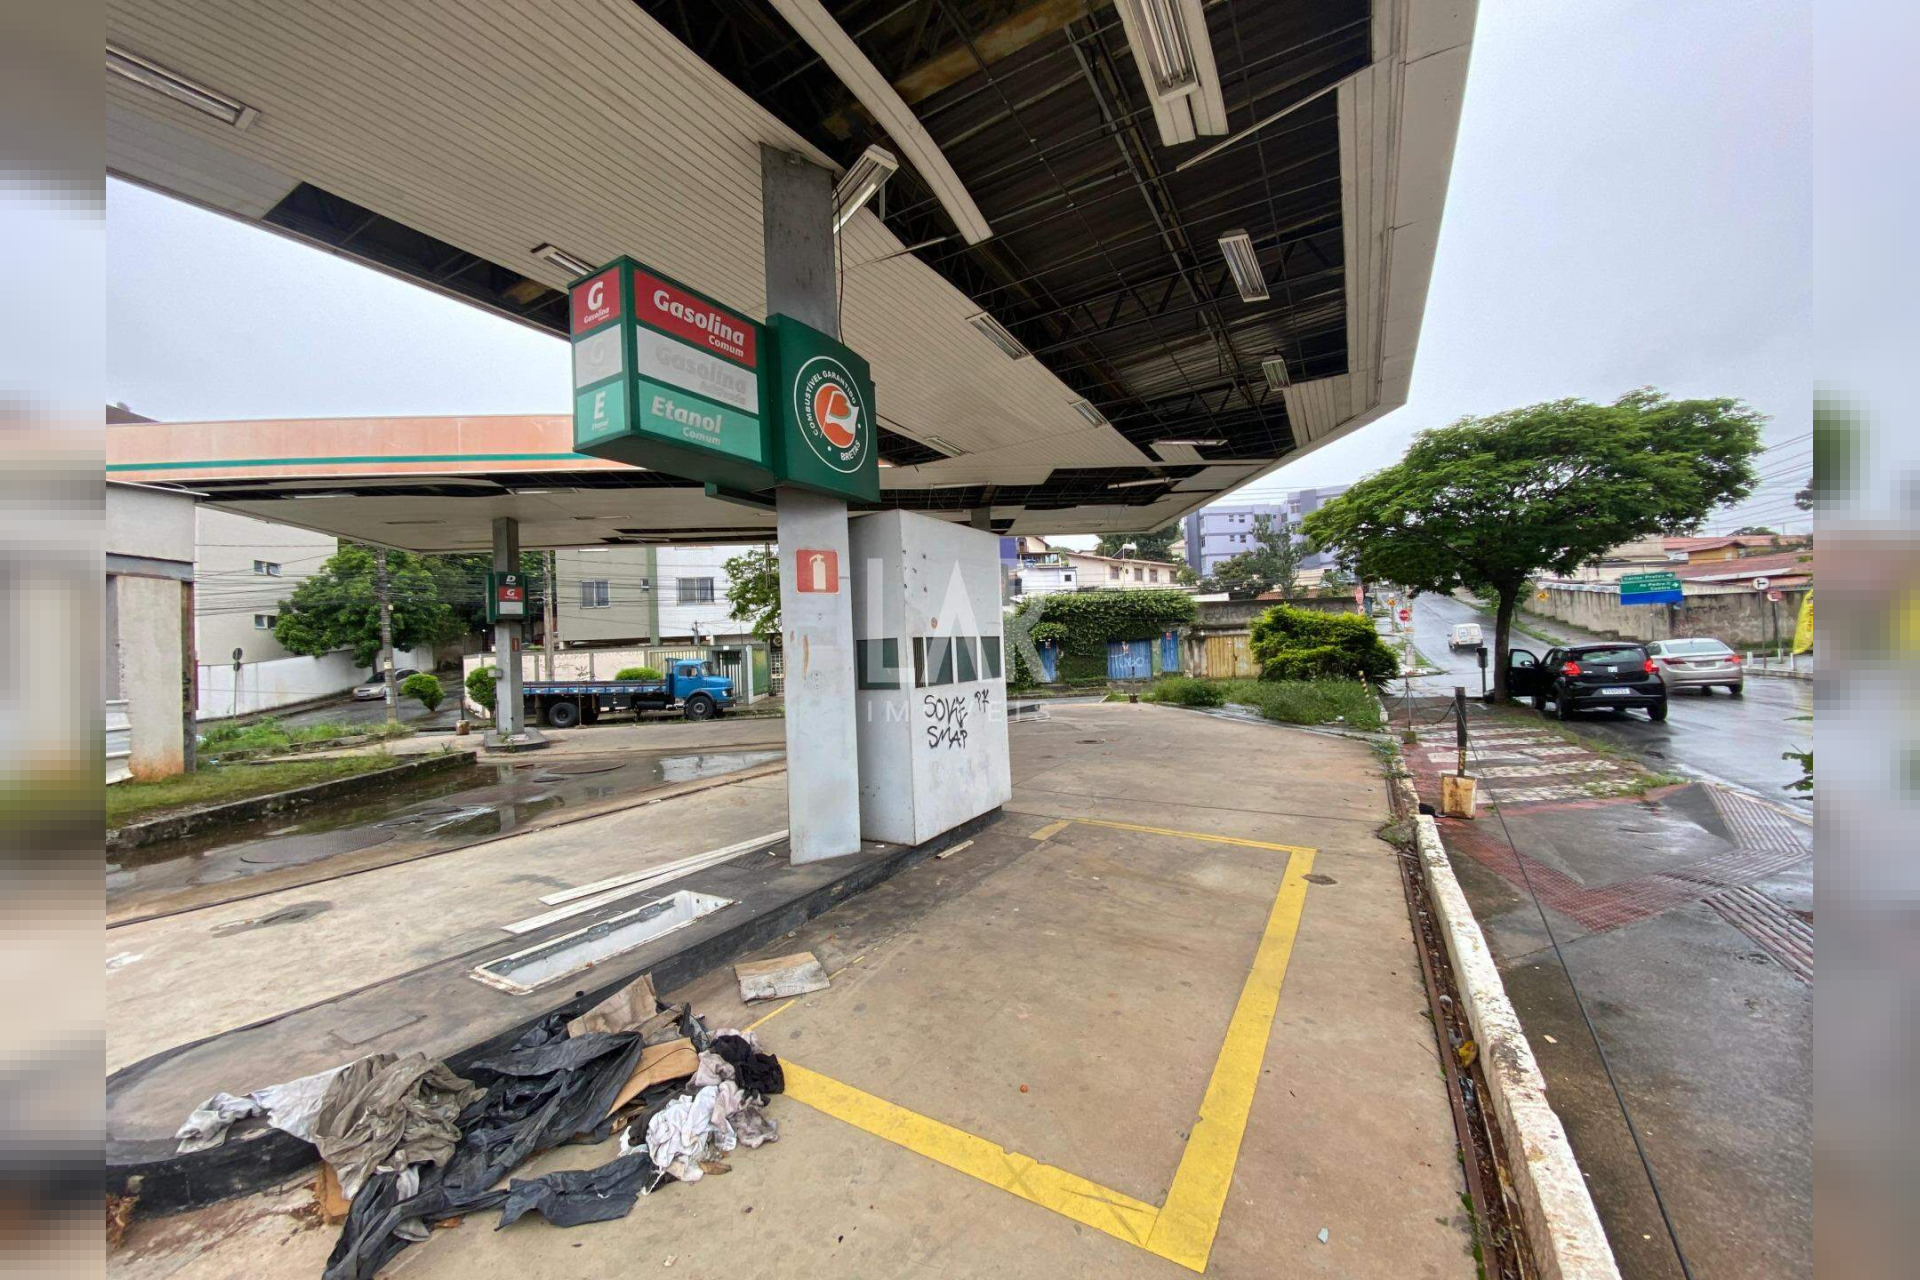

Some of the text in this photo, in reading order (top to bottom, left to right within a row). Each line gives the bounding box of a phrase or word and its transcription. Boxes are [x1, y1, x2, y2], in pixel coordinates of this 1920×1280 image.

[587, 281, 604, 311] G
[653, 289, 745, 346] Gasolina
[708, 334, 744, 358] Comum
[656, 346, 746, 394] Gasolina
[594, 391, 606, 420] E
[651, 395, 722, 433] Etanol
[804, 373, 822, 436] COMBUSTÍVEL
[822, 370, 856, 404] GARANTIDO
[682, 427, 721, 446] Comum
[840, 439, 861, 461] BRETAS
